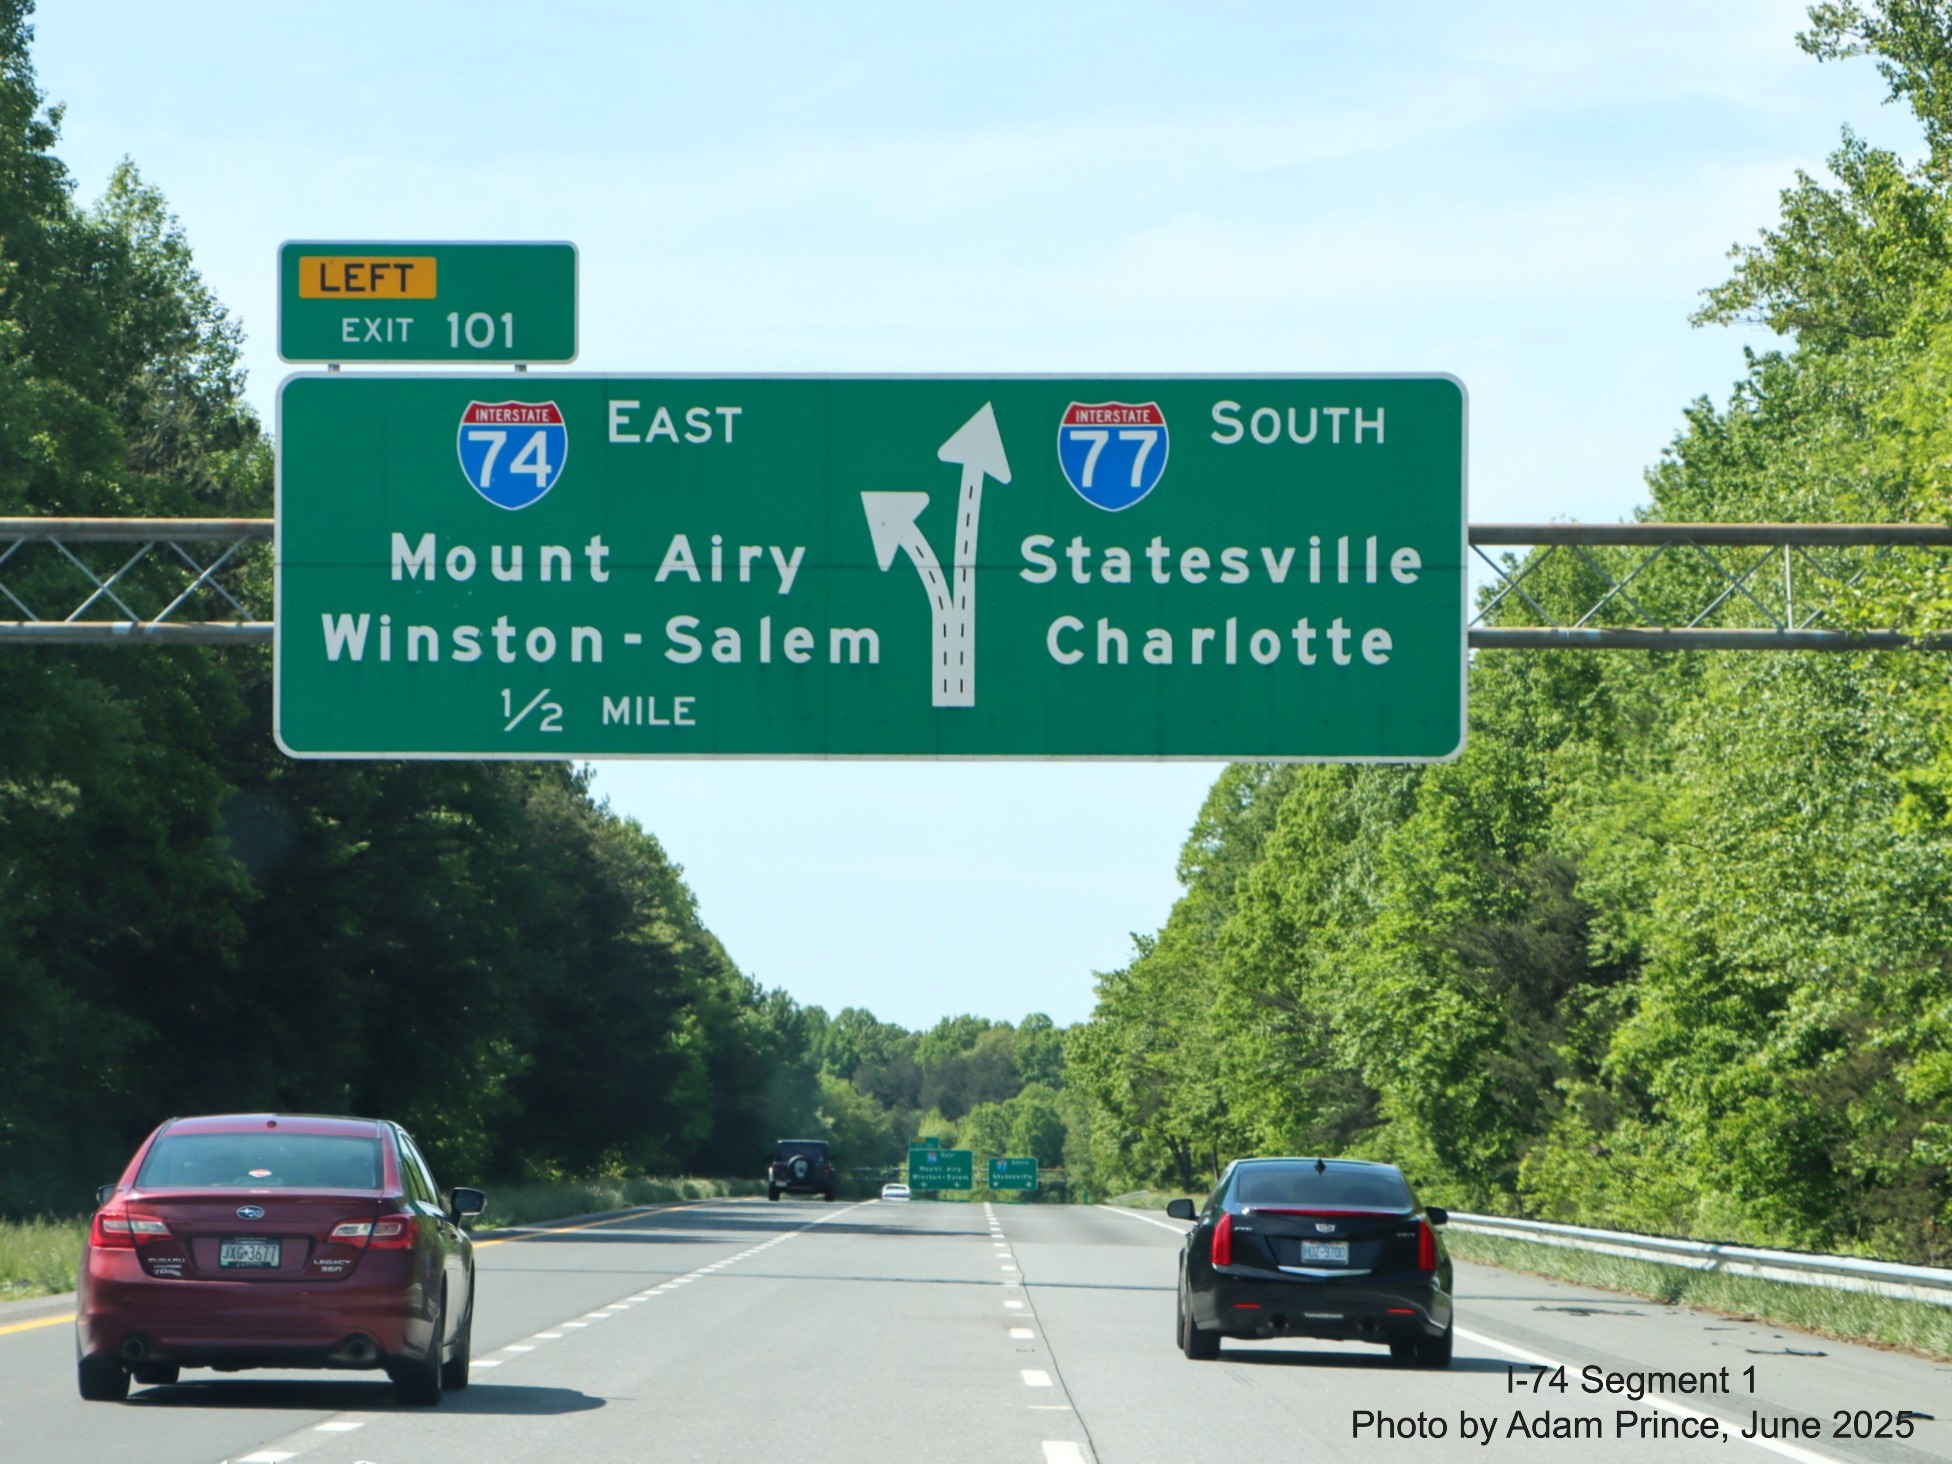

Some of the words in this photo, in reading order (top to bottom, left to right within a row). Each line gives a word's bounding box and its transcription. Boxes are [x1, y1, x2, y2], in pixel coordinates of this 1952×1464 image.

[320, 263, 414, 292] LEFT
[342, 317, 413, 342] EXIT
[447, 312, 513, 348] 101
[475, 409, 549, 423] INTERSTATE
[608, 400, 742, 443] EAST
[1075, 409, 1150, 424] INTERSTATE
[1211, 400, 1385, 444] SOUTH
[468, 431, 552, 488] 74
[1069, 430, 1158, 488] 77
[391, 532, 609, 583] Mount
[655, 534, 806, 594] Airy
[1019, 534, 1422, 584] Statesville
[1046, 615, 1393, 666] Charlotte
[501, 688, 564, 731] 1/2
[603, 696, 696, 725] MILE
